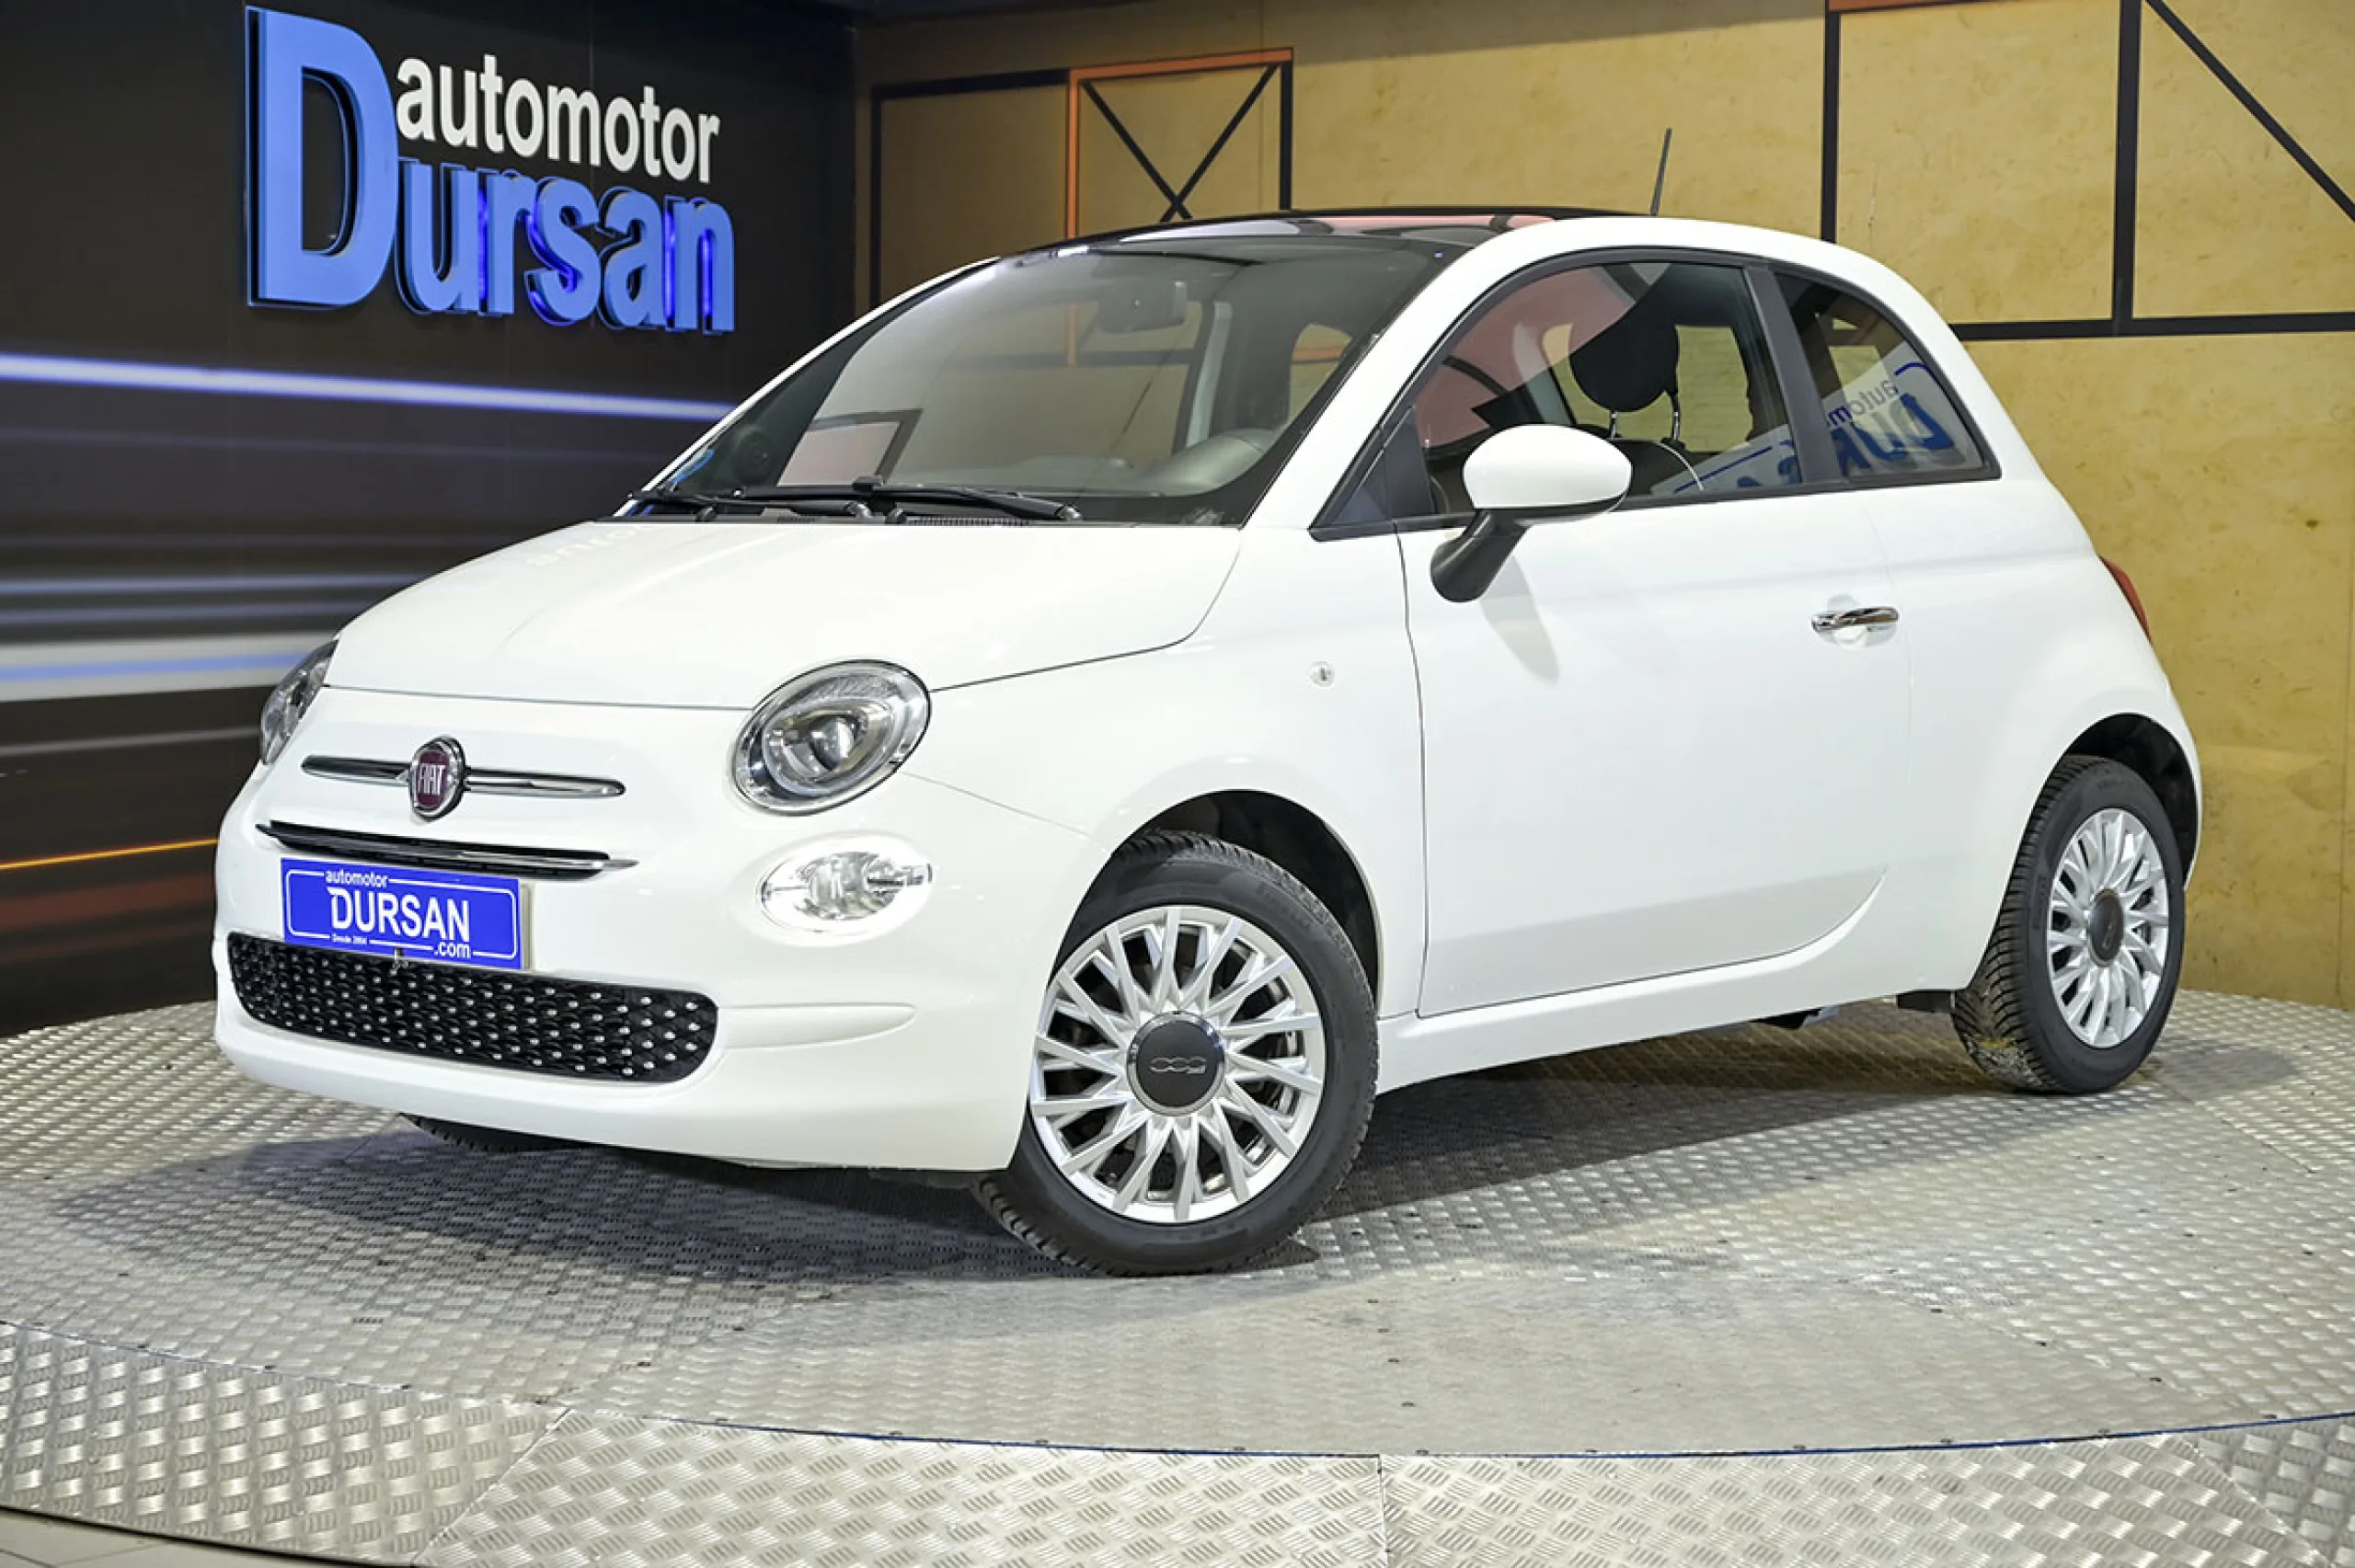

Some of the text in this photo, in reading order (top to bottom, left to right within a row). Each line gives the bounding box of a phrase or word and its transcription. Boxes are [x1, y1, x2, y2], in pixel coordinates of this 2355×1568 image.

[396, 53, 720, 183] automotor
[246, 6, 735, 335] Dursan
[417, 762, 446, 795] FIAT
[325, 868, 389, 888] automotor
[327, 887, 470, 943] DURSAN
[434, 941, 471, 959] .com
